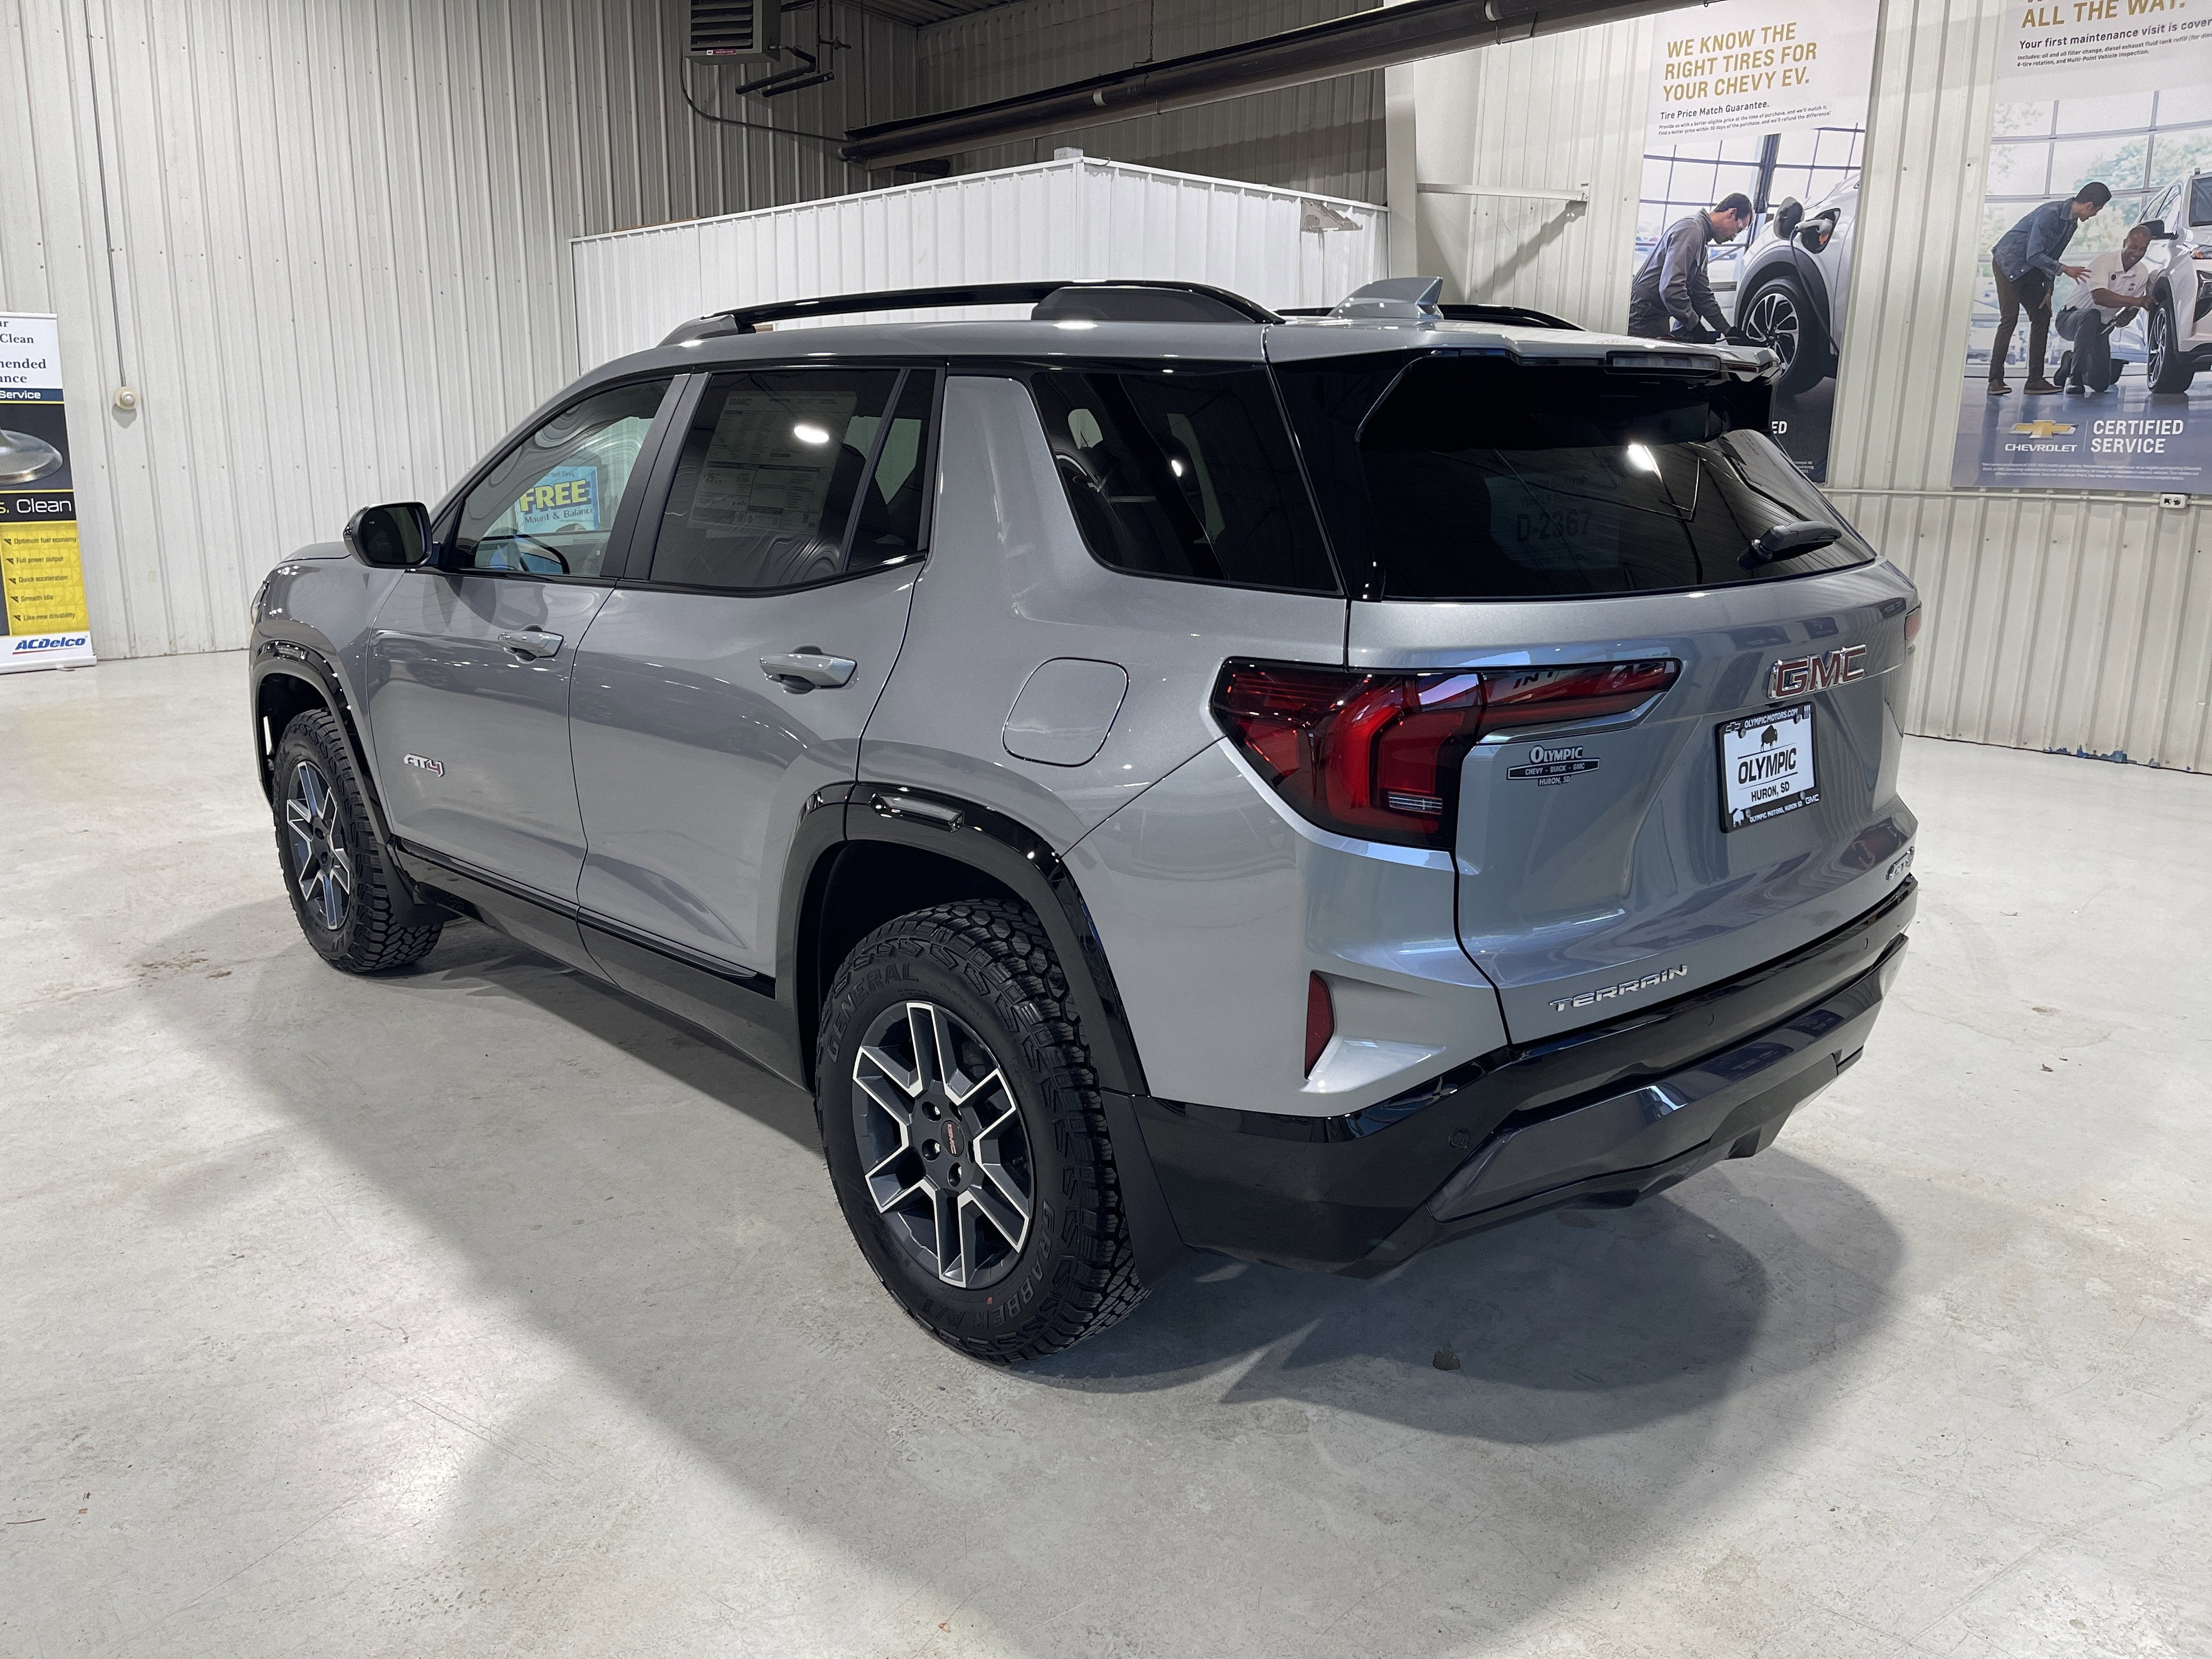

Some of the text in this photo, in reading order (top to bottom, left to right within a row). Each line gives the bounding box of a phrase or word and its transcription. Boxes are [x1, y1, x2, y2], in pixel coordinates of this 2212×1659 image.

[2021, 5, 2064, 28] ALL
[2073, 0, 2119, 22] THE
[1667, 22, 1797, 58] WE KNOW THE
[2019, 40, 2042, 49] Your
[2045, 37, 2067, 47] first
[2070, 30, 2138, 45] maintenance
[2142, 25, 2165, 36] visit
[2168, 22, 2177, 32] is
[1664, 42, 1817, 80] RIGHT TIRES FOR
[2067, 55, 2097, 63] Multi-Point
[1663, 66, 1809, 102] YOUR CHEVY EV.
[1660, 111, 1675, 120] Tire
[1677, 110, 1697, 119] Price
[1700, 105, 1723, 116] Match
[0, 333, 34, 344] Clean
[0, 390, 41, 399] Service
[2093, 419, 2184, 435] CERTIFIED
[2005, 443, 2078, 453] CHEVROLET
[2090, 438, 2166, 454] SERVICE
[519, 479, 588, 512] FREE
[16, 498, 71, 513] Clean
[524, 507, 595, 524] Mount & Balance
[15, 637, 86, 651] ACDelco
[1767, 644, 1866, 699] GMC
[1530, 746, 1583, 763] OLYMPIC
[404, 753, 444, 777] AT4
[1738, 747, 1797, 785] OLYMPIC
[1539, 777, 1562, 786] HURON,
[1751, 781, 1790, 803] HURON, SD
[1805, 794, 1819, 804] GMC
[1749, 812, 1768, 823] OLYMPIC
[1549, 964, 1688, 1012] TERRAIN
[826, 963, 919, 1063] GENERAL
[947, 1123, 957, 1154] GMC
